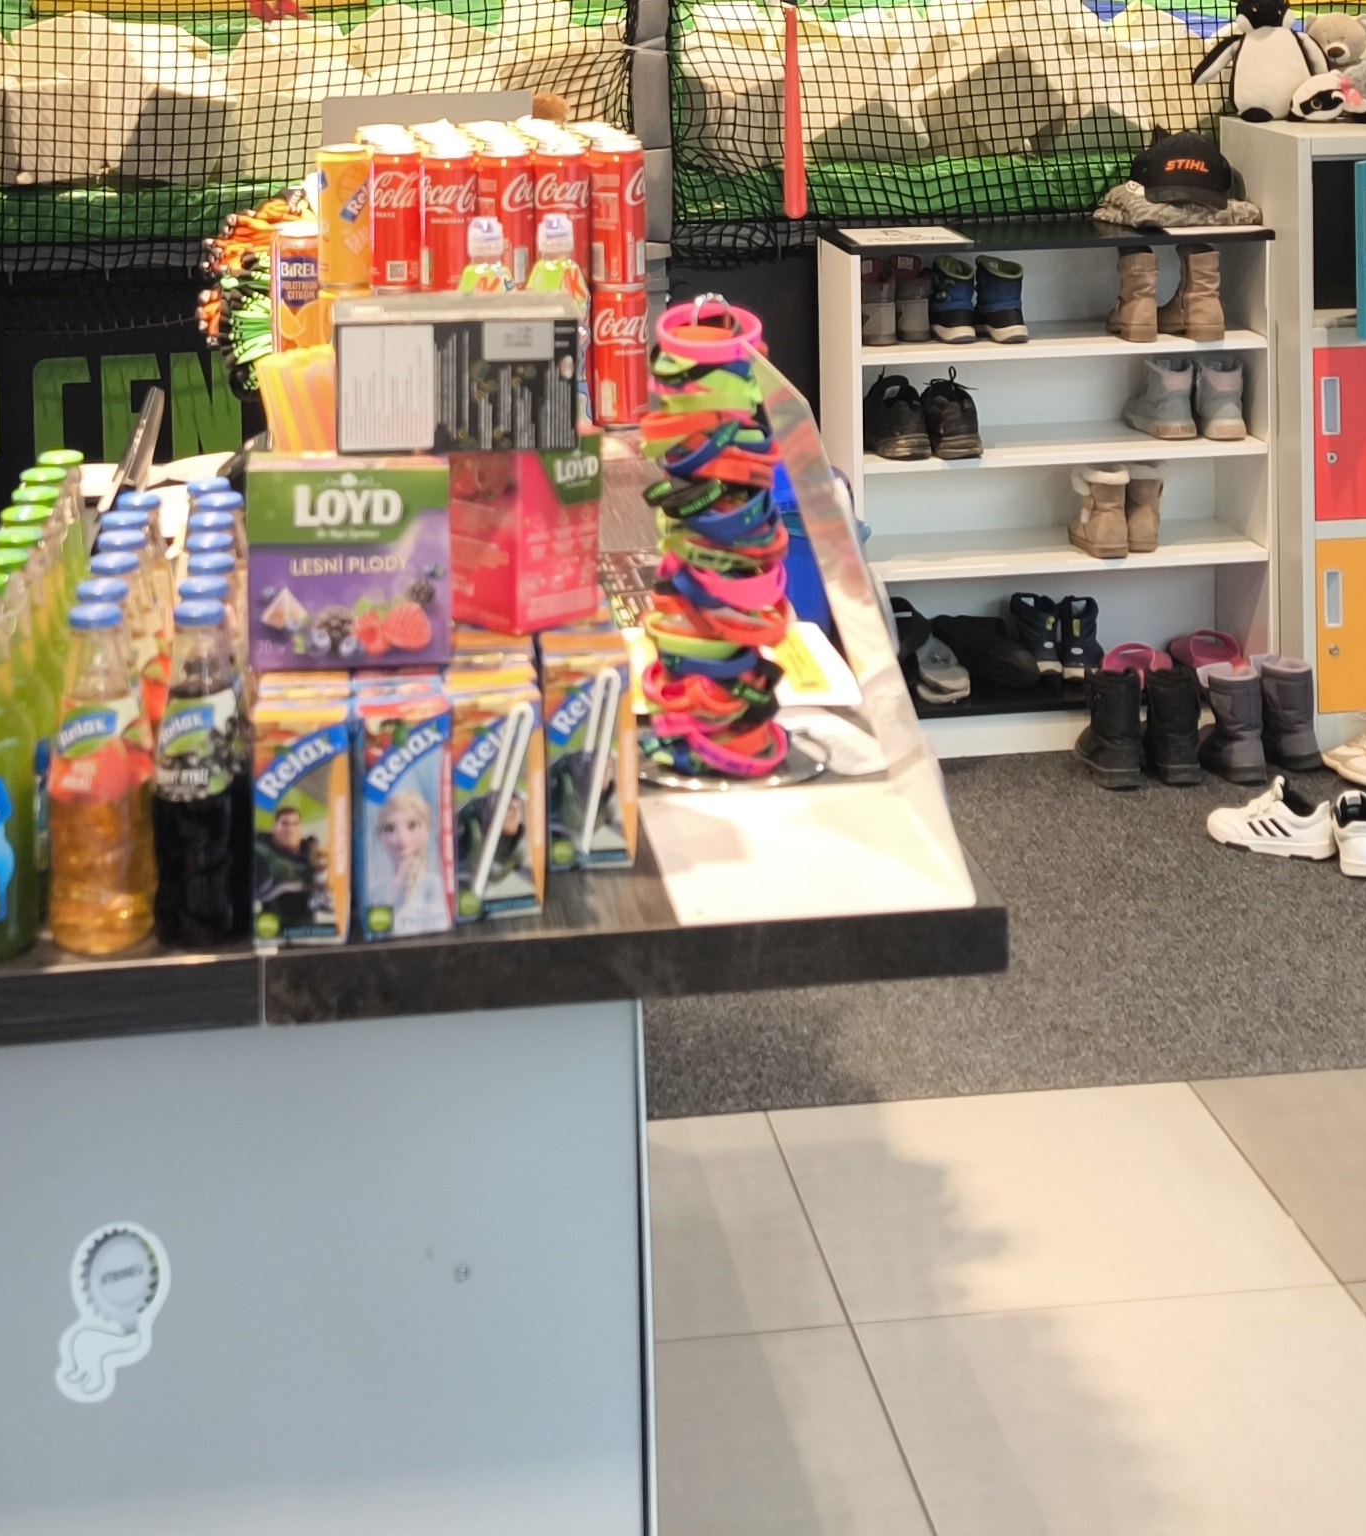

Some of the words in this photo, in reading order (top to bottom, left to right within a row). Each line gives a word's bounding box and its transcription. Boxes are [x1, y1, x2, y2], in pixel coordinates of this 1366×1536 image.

[1165, 158, 1209, 174] STIHL
[555, 455, 599, 484] LOYD
[294, 484, 403, 527] LOYD
[291, 553, 344, 577] LESNÍ
[349, 555, 407, 575] PLODY
[256, 735, 335, 800] Relax
[366, 724, 443, 794] Relax
